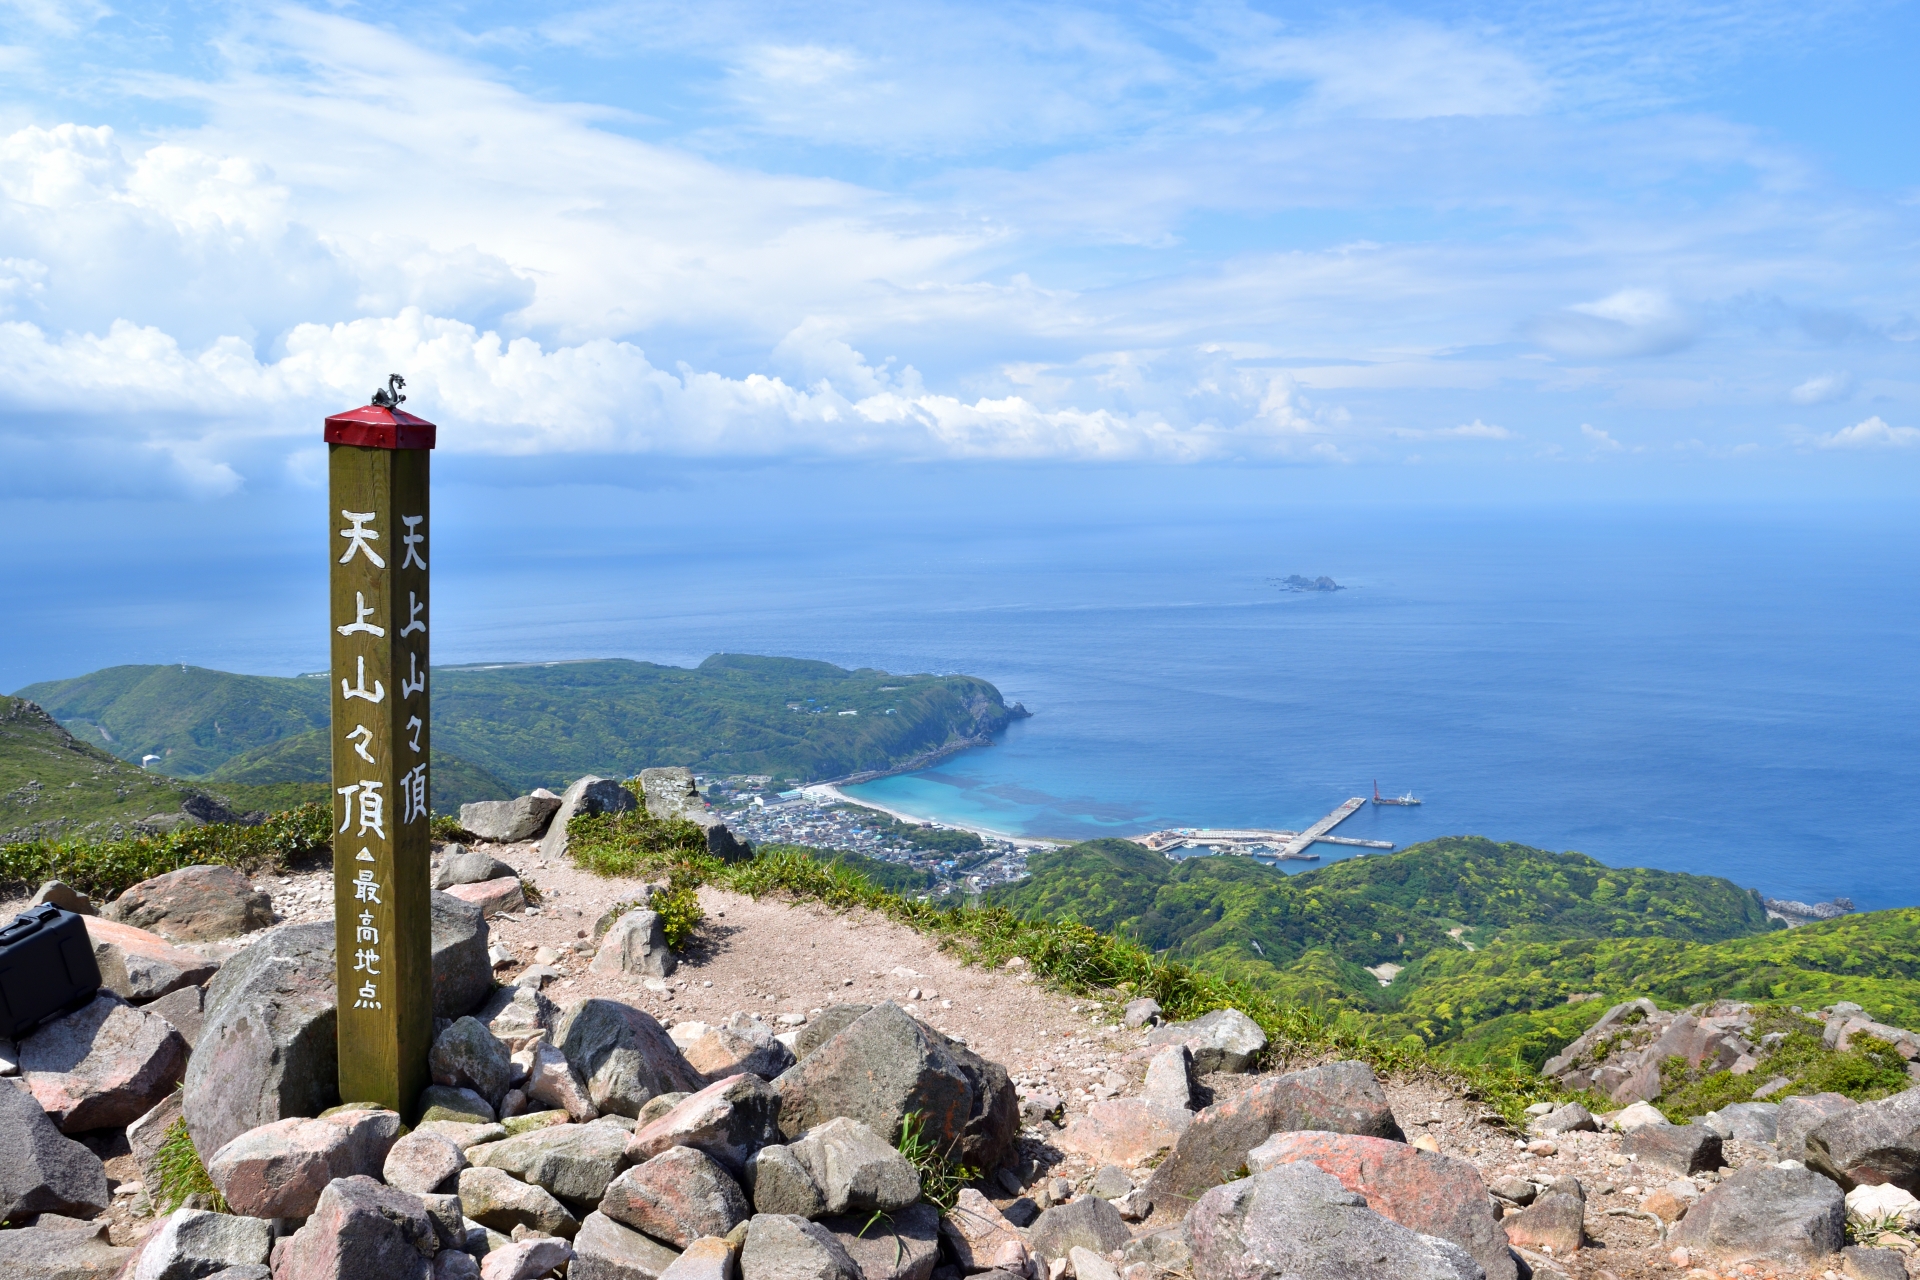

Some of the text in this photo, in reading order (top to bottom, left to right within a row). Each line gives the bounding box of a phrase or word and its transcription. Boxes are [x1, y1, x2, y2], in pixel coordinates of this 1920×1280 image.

[336, 509, 386, 840] 天上山々頂
[400, 513, 428, 825] 天上山々頂
[352, 869, 382, 1010] 最高地点
